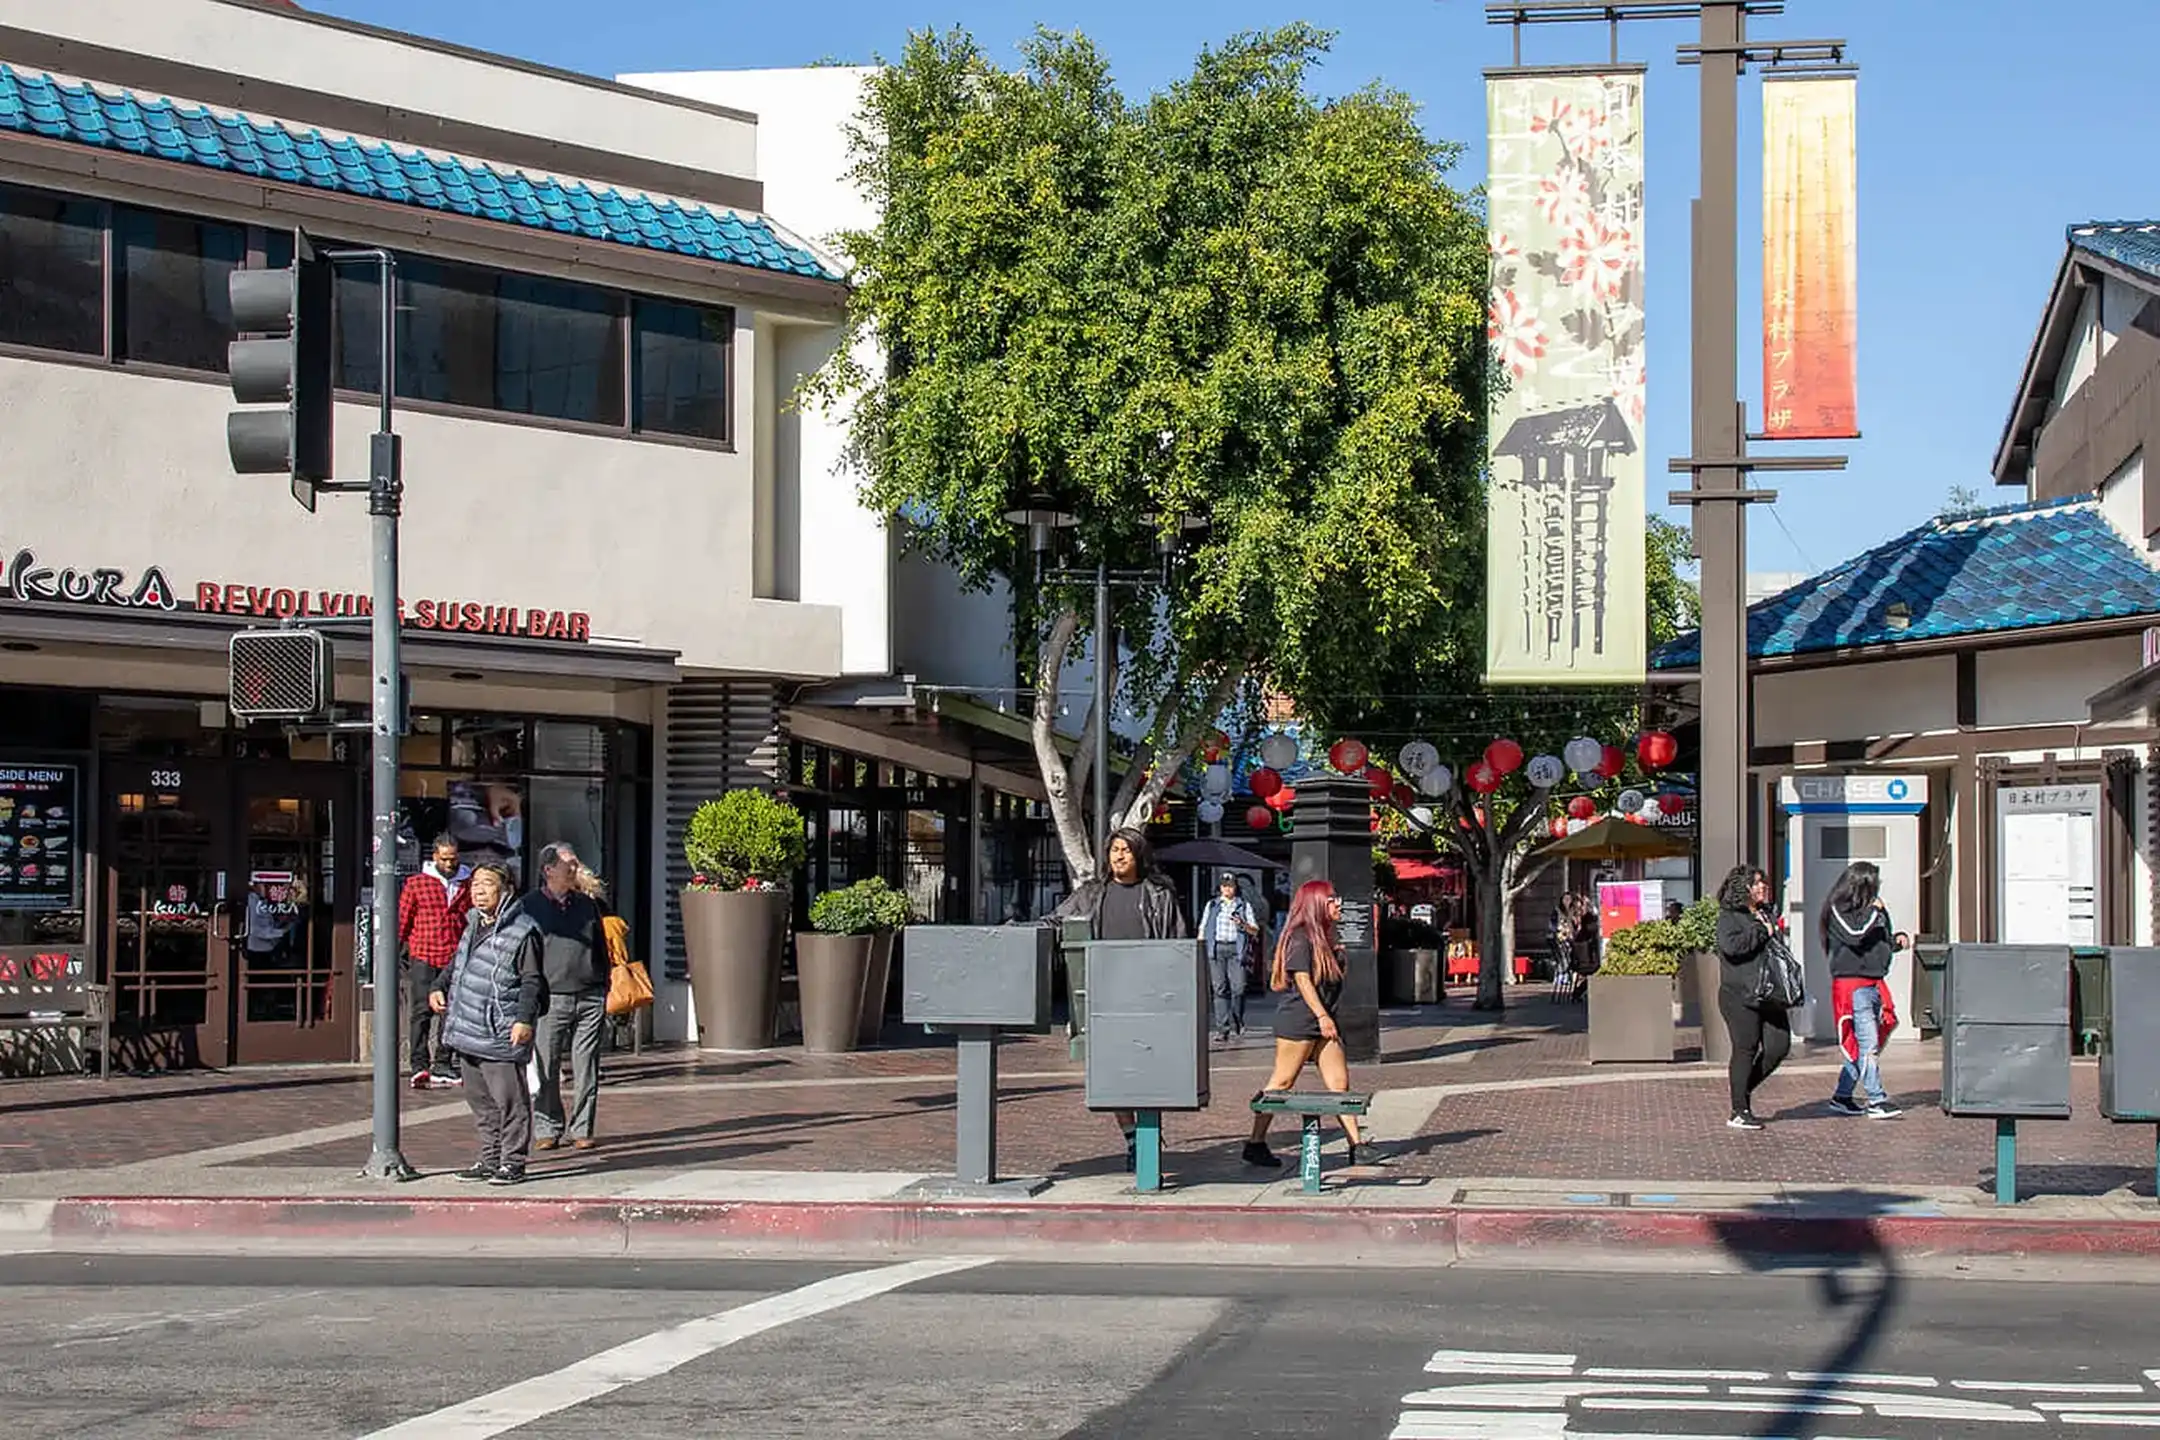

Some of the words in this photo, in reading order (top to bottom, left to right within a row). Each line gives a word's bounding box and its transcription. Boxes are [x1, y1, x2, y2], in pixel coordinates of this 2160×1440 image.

[10, 548, 177, 610] KURA
[414, 599, 518, 635] SUSHI
[527, 608, 590, 640] BAR
[28, 771, 63, 781] MENU
[151, 770, 181, 787] 333
[1802, 782, 1882, 798] CHASE
[155, 900, 199, 916] KURA
[256, 900, 299, 916] KURA
